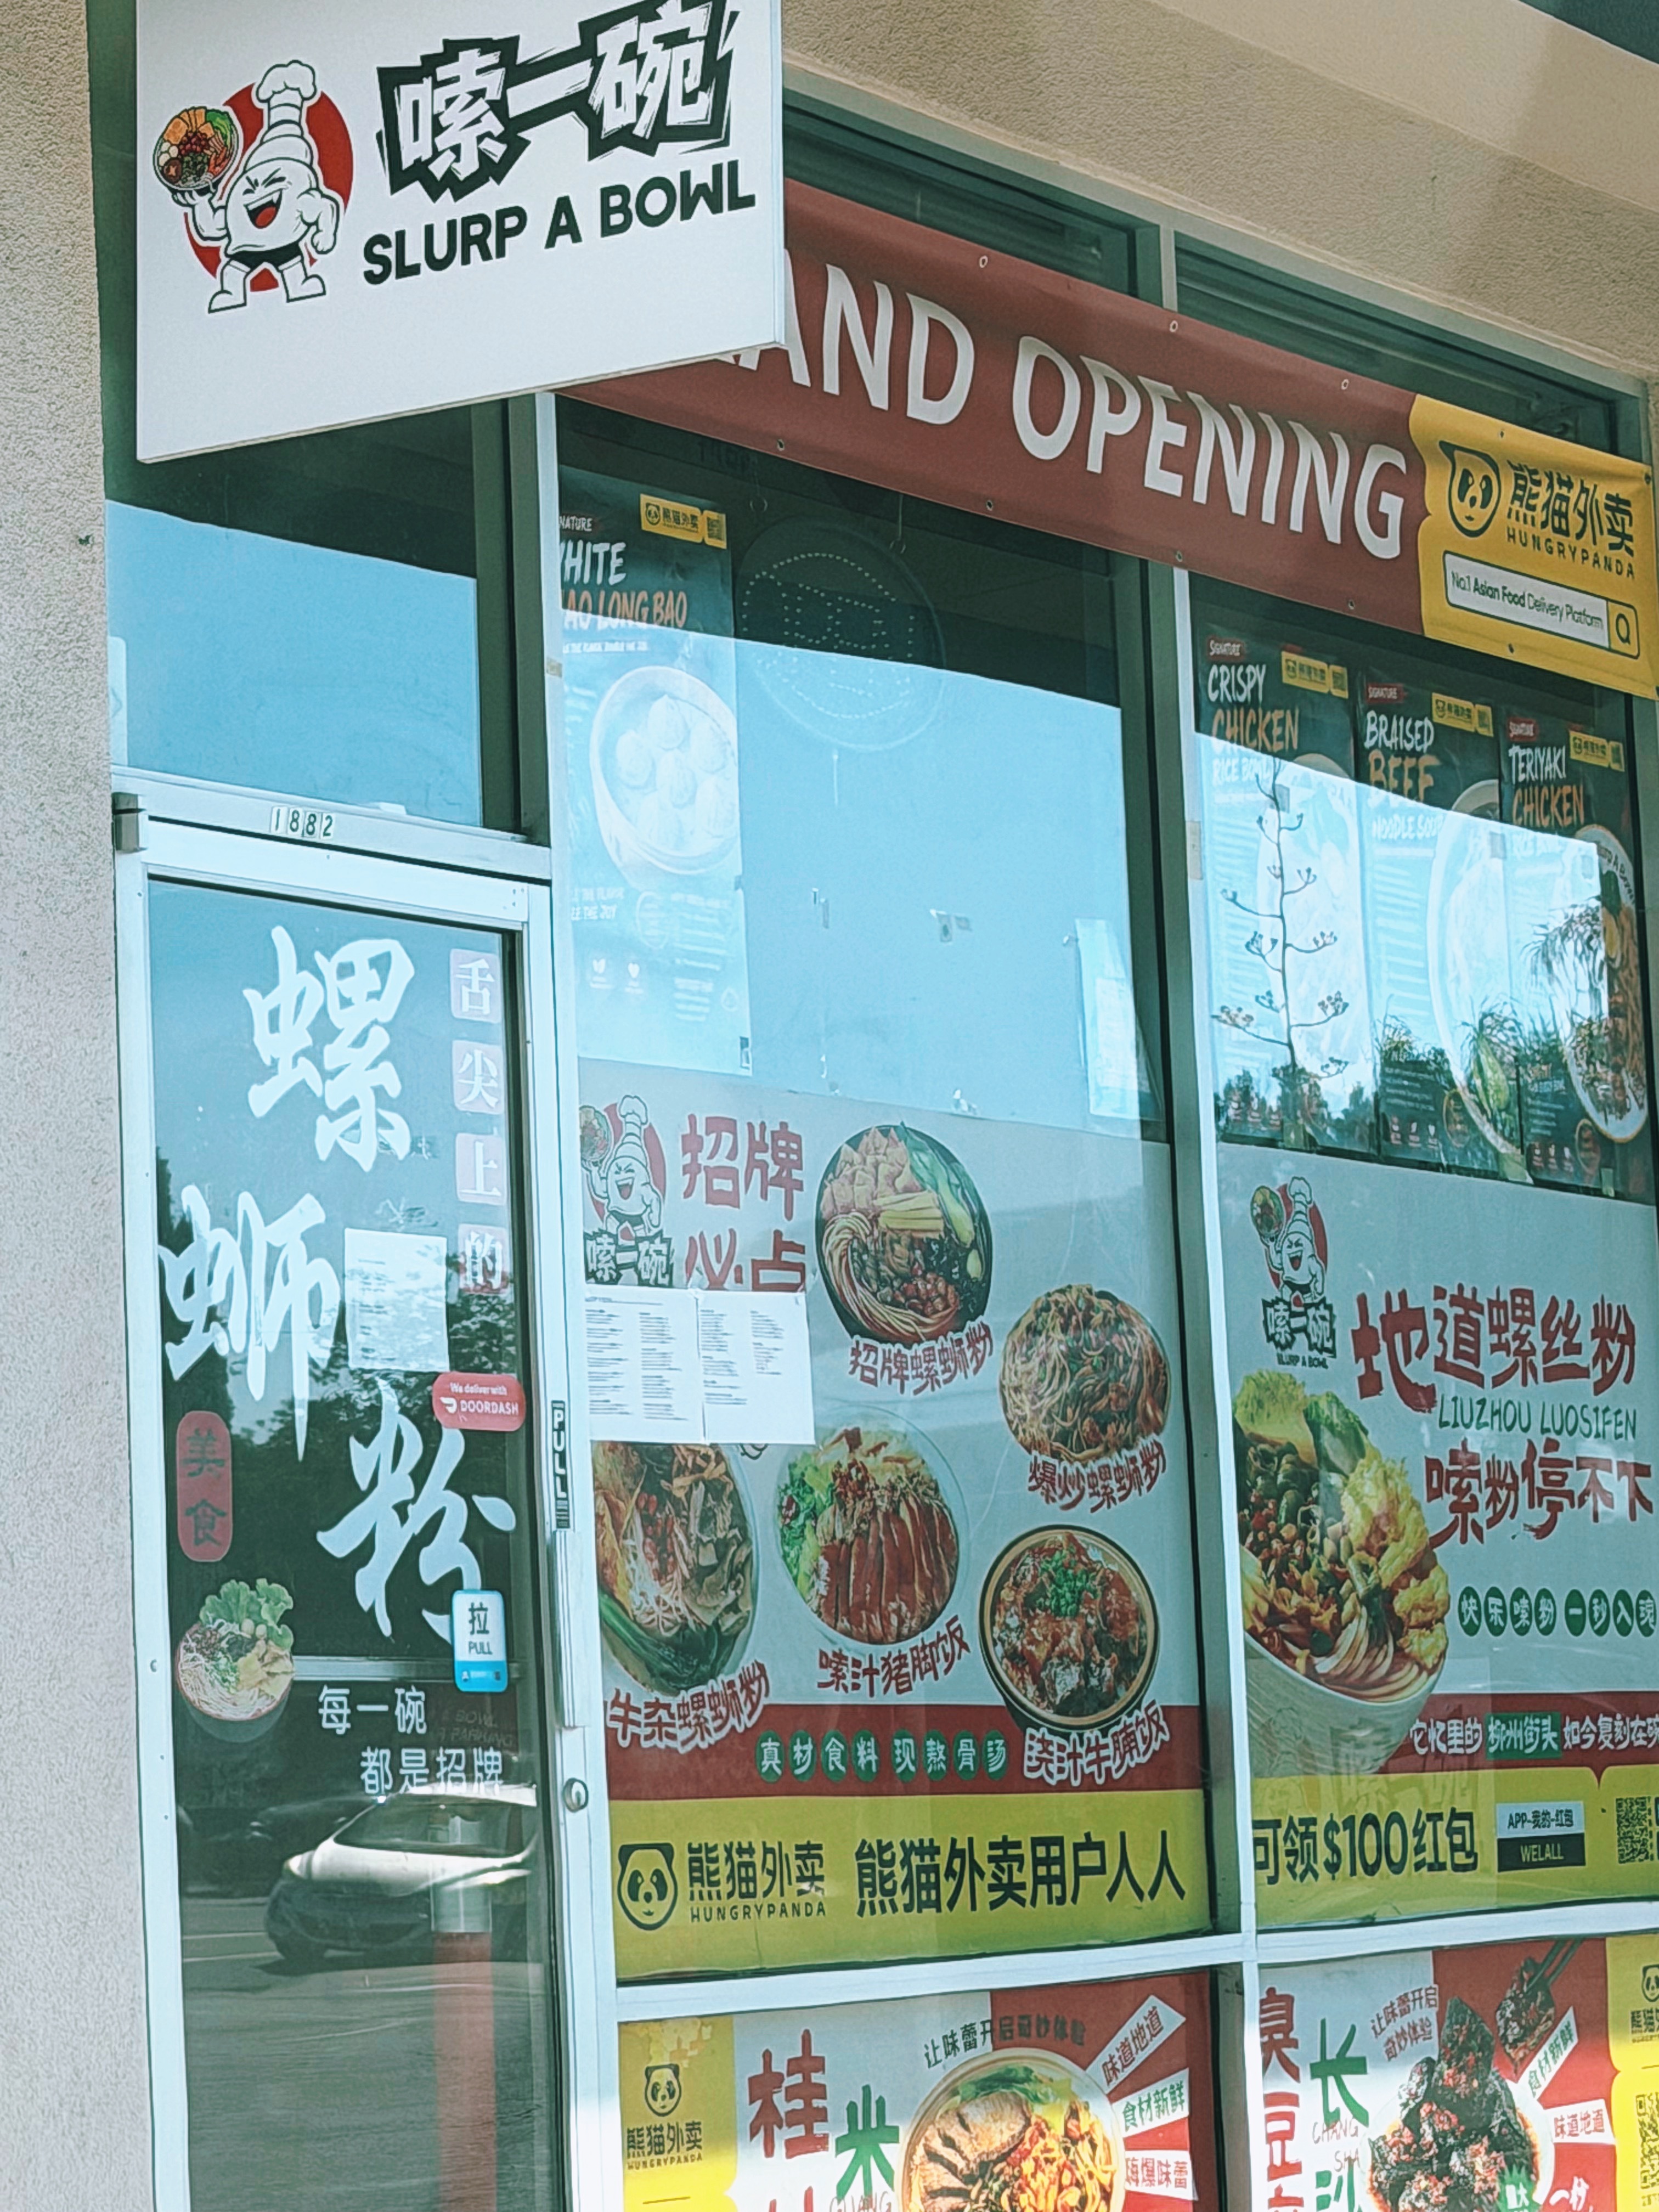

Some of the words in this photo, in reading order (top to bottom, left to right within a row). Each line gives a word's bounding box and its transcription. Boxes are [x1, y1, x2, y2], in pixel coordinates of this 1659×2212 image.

[379, 0, 735, 201] 嗦一碗
[362, 205, 528, 285] SLURP
[545, 195, 582, 249] A
[600, 159, 756, 239] BOWL
[738, 249, 974, 425] AND
[1012, 336, 1406, 558] OPENING
[1507, 459, 1635, 558] 熊猫外卖
[1507, 526, 1635, 580] HUNGRYPANDA
[561, 589, 592, 630] AO
[652, 590, 688, 629] BAO
[1472, 577, 1500, 601] Asian
[1502, 585, 1526, 608] Food
[1527, 592, 1564, 623] Delivery
[1565, 603, 1604, 630] Platform
[1208, 663, 1267, 703] CRISPY
[1211, 706, 1300, 753] CHICKEN
[1364, 710, 1435, 753] BRAISED
[1368, 749, 1442, 802] BEEF
[1509, 744, 1566, 785] TERIYAKI
[274, 808, 333, 837] 1882
[1513, 784, 1584, 827] CHICKEN
[455, 958, 503, 1290] 舌尖上的
[681, 1113, 804, 1221] 招牌
[1262, 1296, 1337, 1359] 嗦一碗
[1351, 1282, 1636, 1414] 地道螺丝粉
[849, 1321, 994, 1396] 招牌螺蛳粉
[450, 1382, 463, 1393] We
[464, 1383, 490, 1395] deliver
[491, 1384, 507, 1396] with
[460, 1400, 519, 1416] DOORDASH
[1438, 1393, 1532, 1434] LIUZHOU
[1539, 1401, 1637, 1442] LUOSIFEN
[553, 1409, 567, 1499] PULL
[1028, 1439, 1167, 1514] 爆炒螺蛳粉
[181, 1428, 227, 1548] 美食
[1424, 1437, 1653, 1552] 嗦粉停不下
[467, 1601, 488, 1635] 拉
[1460, 1592, 1555, 1630] 快乐嗦粉
[1568, 1596, 1657, 1631] 一秒入魂
[467, 1640, 493, 1656] PULL
[817, 1615, 972, 1699] 嗦汁猪脚饭
[318, 1684, 428, 1735] 每一碗
[606, 1658, 769, 1752] 牛杂螺蛳粉
[759, 1736, 879, 1776] 真材食料
[893, 1736, 1007, 1774] 现熬骨汤
[1487, 1715, 1558, 1754] 柳州街头
[359, 1746, 504, 1796] 都是招牌
[1252, 1807, 1479, 1886] 可领$100红包
[1520, 1842, 1565, 1863] WELALL
[687, 1839, 825, 1901] 熊猫外卖
[854, 1829, 1186, 1918] 熊猫外卖用户人人
[690, 1901, 826, 1923] HUNGRYPANDA
[1370, 1985, 1438, 2039] 让味蕾开启
[1101, 2006, 1164, 2085] 味道地道
[1383, 2016, 1432, 2062] 奇妙体验
[1527, 2020, 1575, 2098] 食材新鲜
[1121, 2079, 1186, 2131] 食材新鲜
[1554, 2108, 1606, 2140] 味道地道
[627, 2120, 703, 2159] 熊猫外卖
[1312, 2118, 1358, 2144] CHANG
[627, 2152, 703, 2170] HUNGRYPANDA
